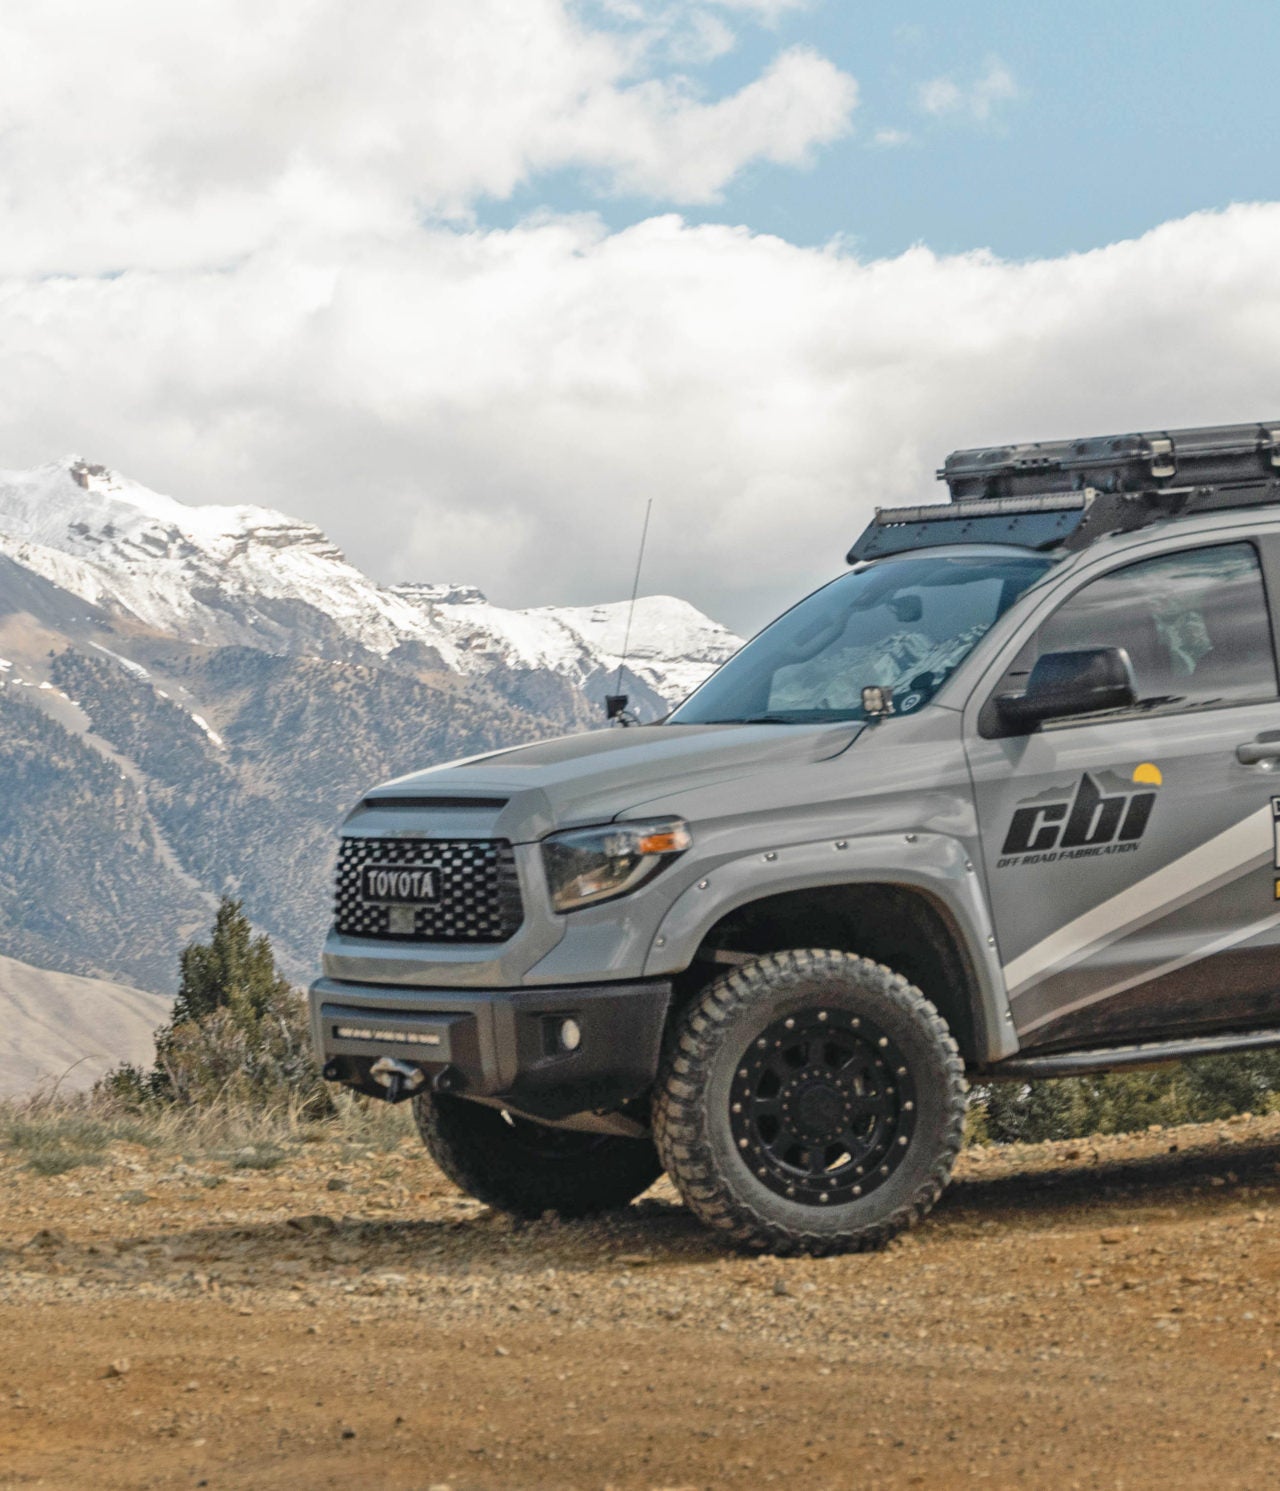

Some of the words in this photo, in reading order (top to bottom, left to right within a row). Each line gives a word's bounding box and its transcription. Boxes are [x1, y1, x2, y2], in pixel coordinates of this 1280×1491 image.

[997, 857, 1021, 869] OFF
[1022, 851, 1058, 865] ROAD
[1058, 842, 1140, 861] FABRICATION
[367, 870, 435, 898] TOYOTA
